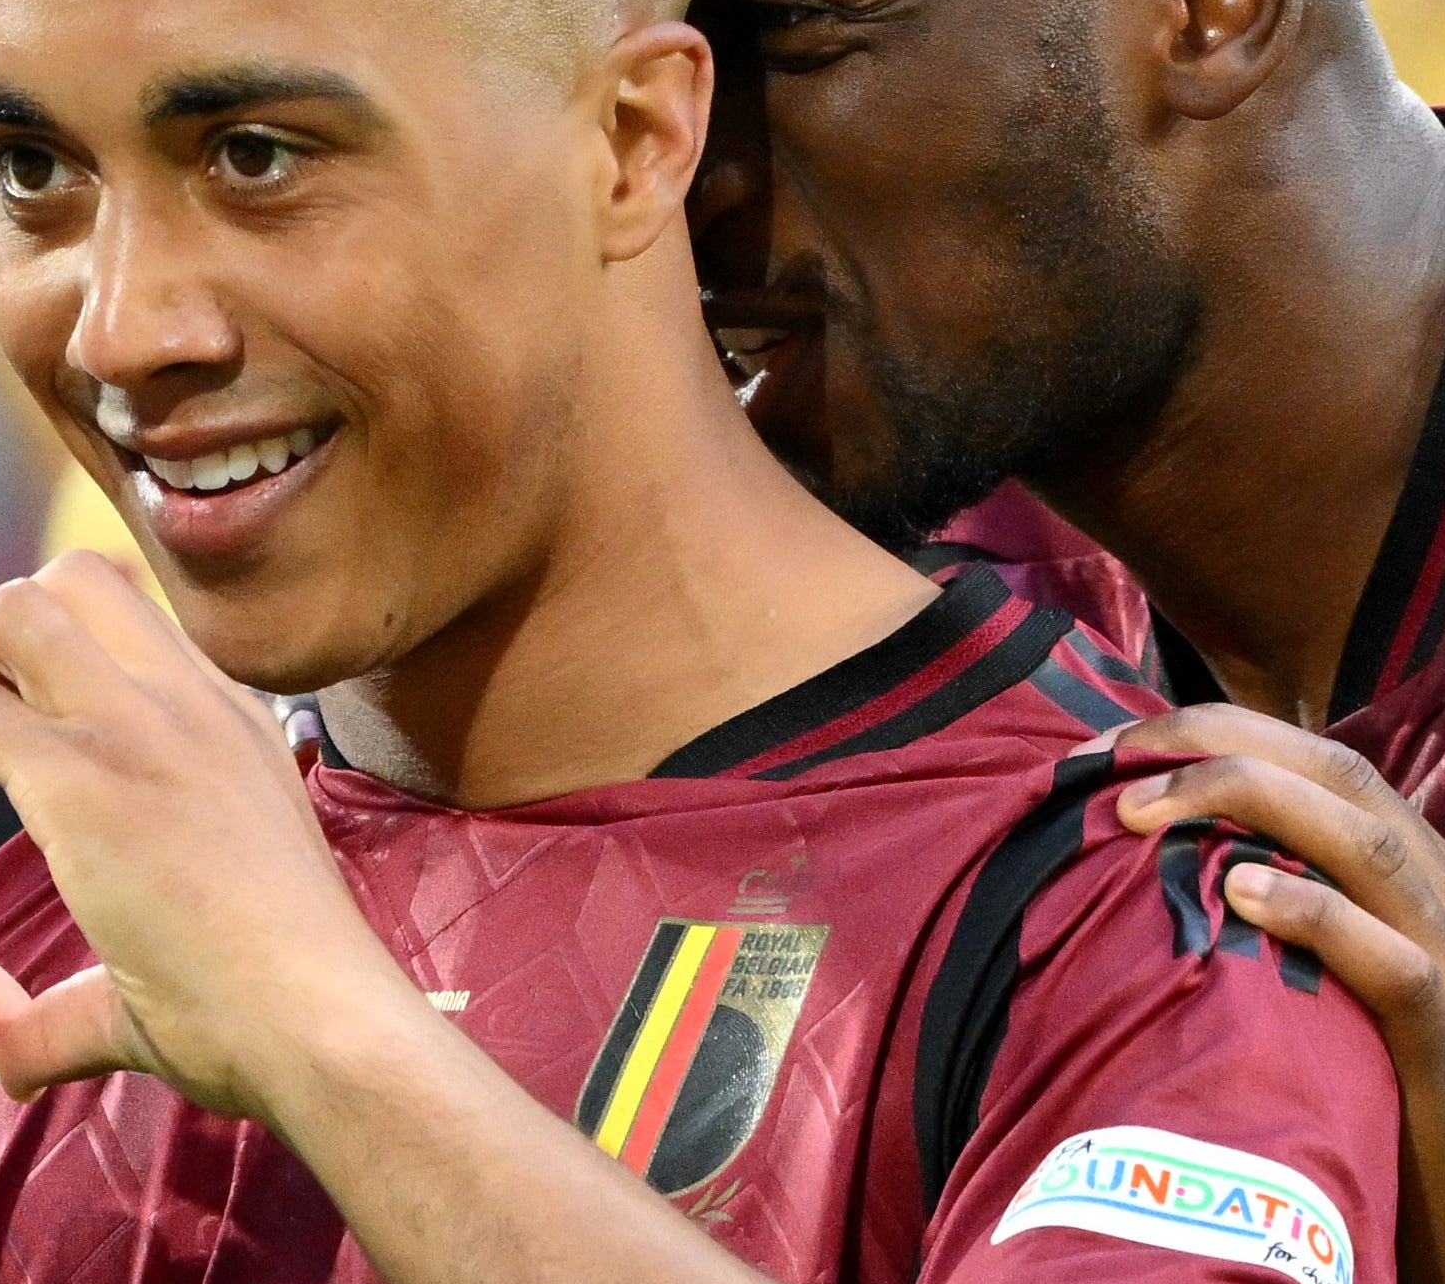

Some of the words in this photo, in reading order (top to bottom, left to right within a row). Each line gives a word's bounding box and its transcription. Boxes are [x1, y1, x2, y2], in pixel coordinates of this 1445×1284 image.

[740, 932, 802, 952] ROYAL
[731, 955, 817, 976] BELGIAN
[721, 978, 747, 997] FA
[1262, 1241, 1298, 1263] for
